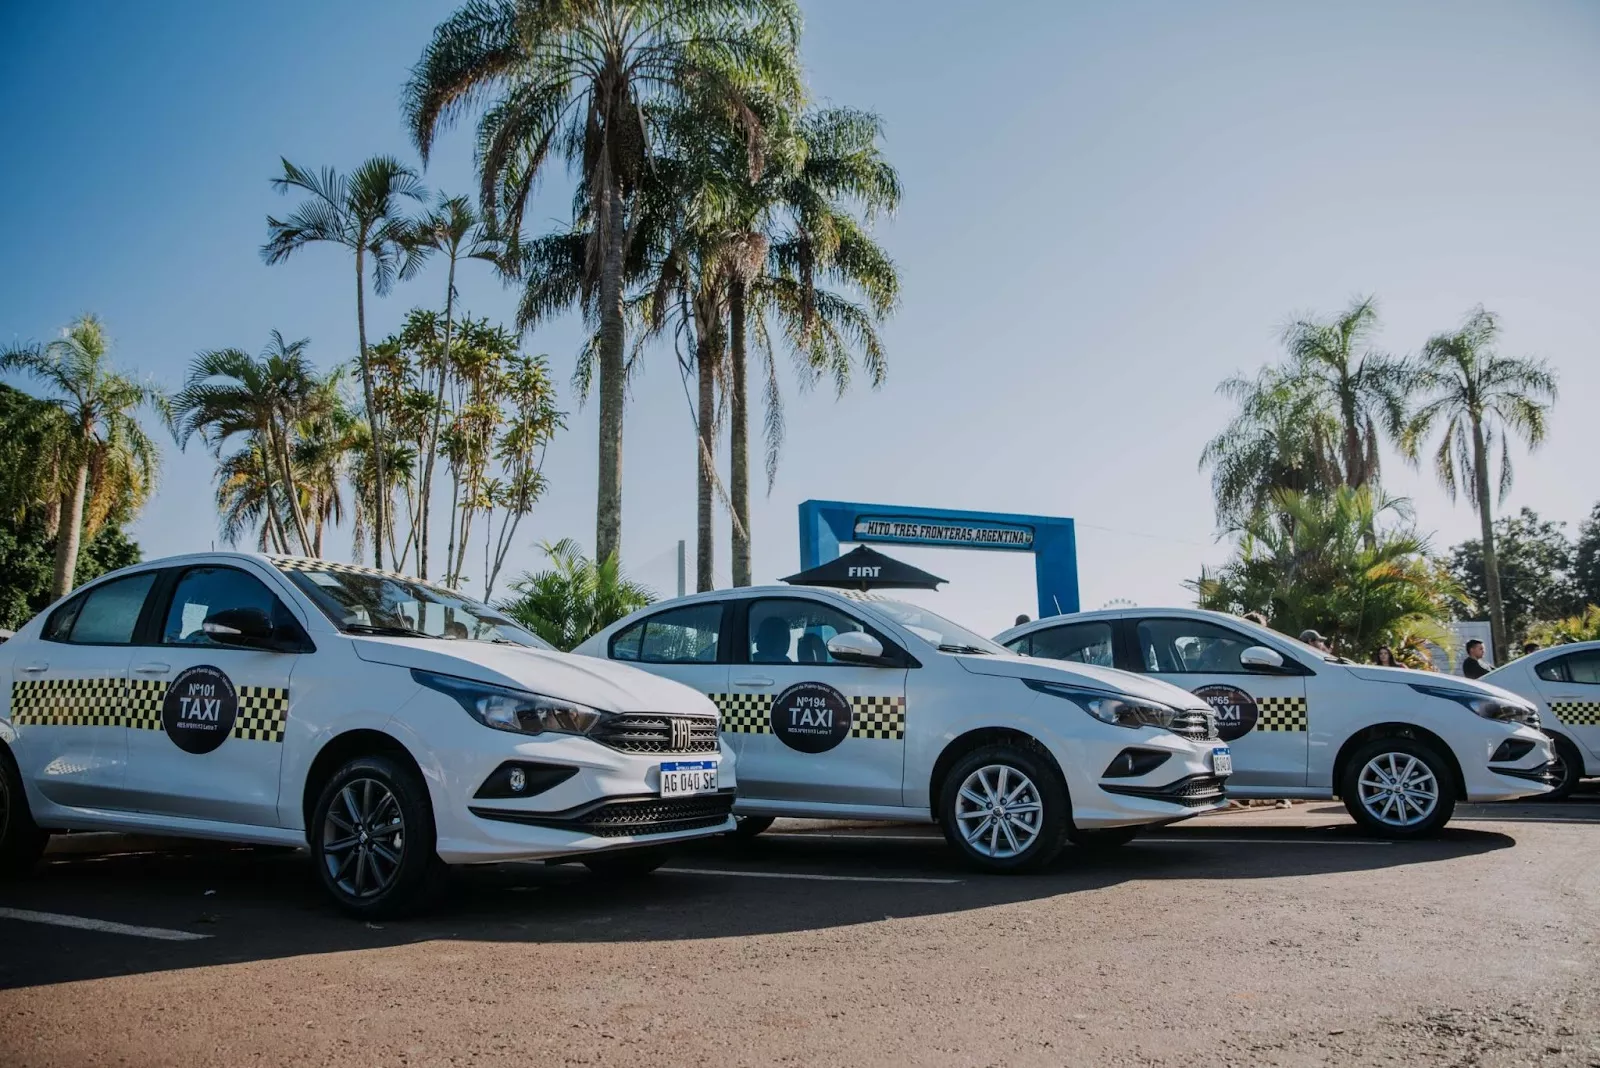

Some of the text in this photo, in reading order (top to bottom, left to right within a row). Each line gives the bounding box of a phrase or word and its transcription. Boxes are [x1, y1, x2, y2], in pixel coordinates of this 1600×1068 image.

[867, 521, 1024, 544] HITO TRES FRONTERAS ARGENTINA
[848, 566, 881, 577] FIAT
[180, 698, 221, 721] TAXI
[788, 708, 833, 728] TAXI
[1213, 705, 1240, 720] AXI
[671, 719, 691, 749] FIAT
[664, 772, 715, 793] AG 040 SE
